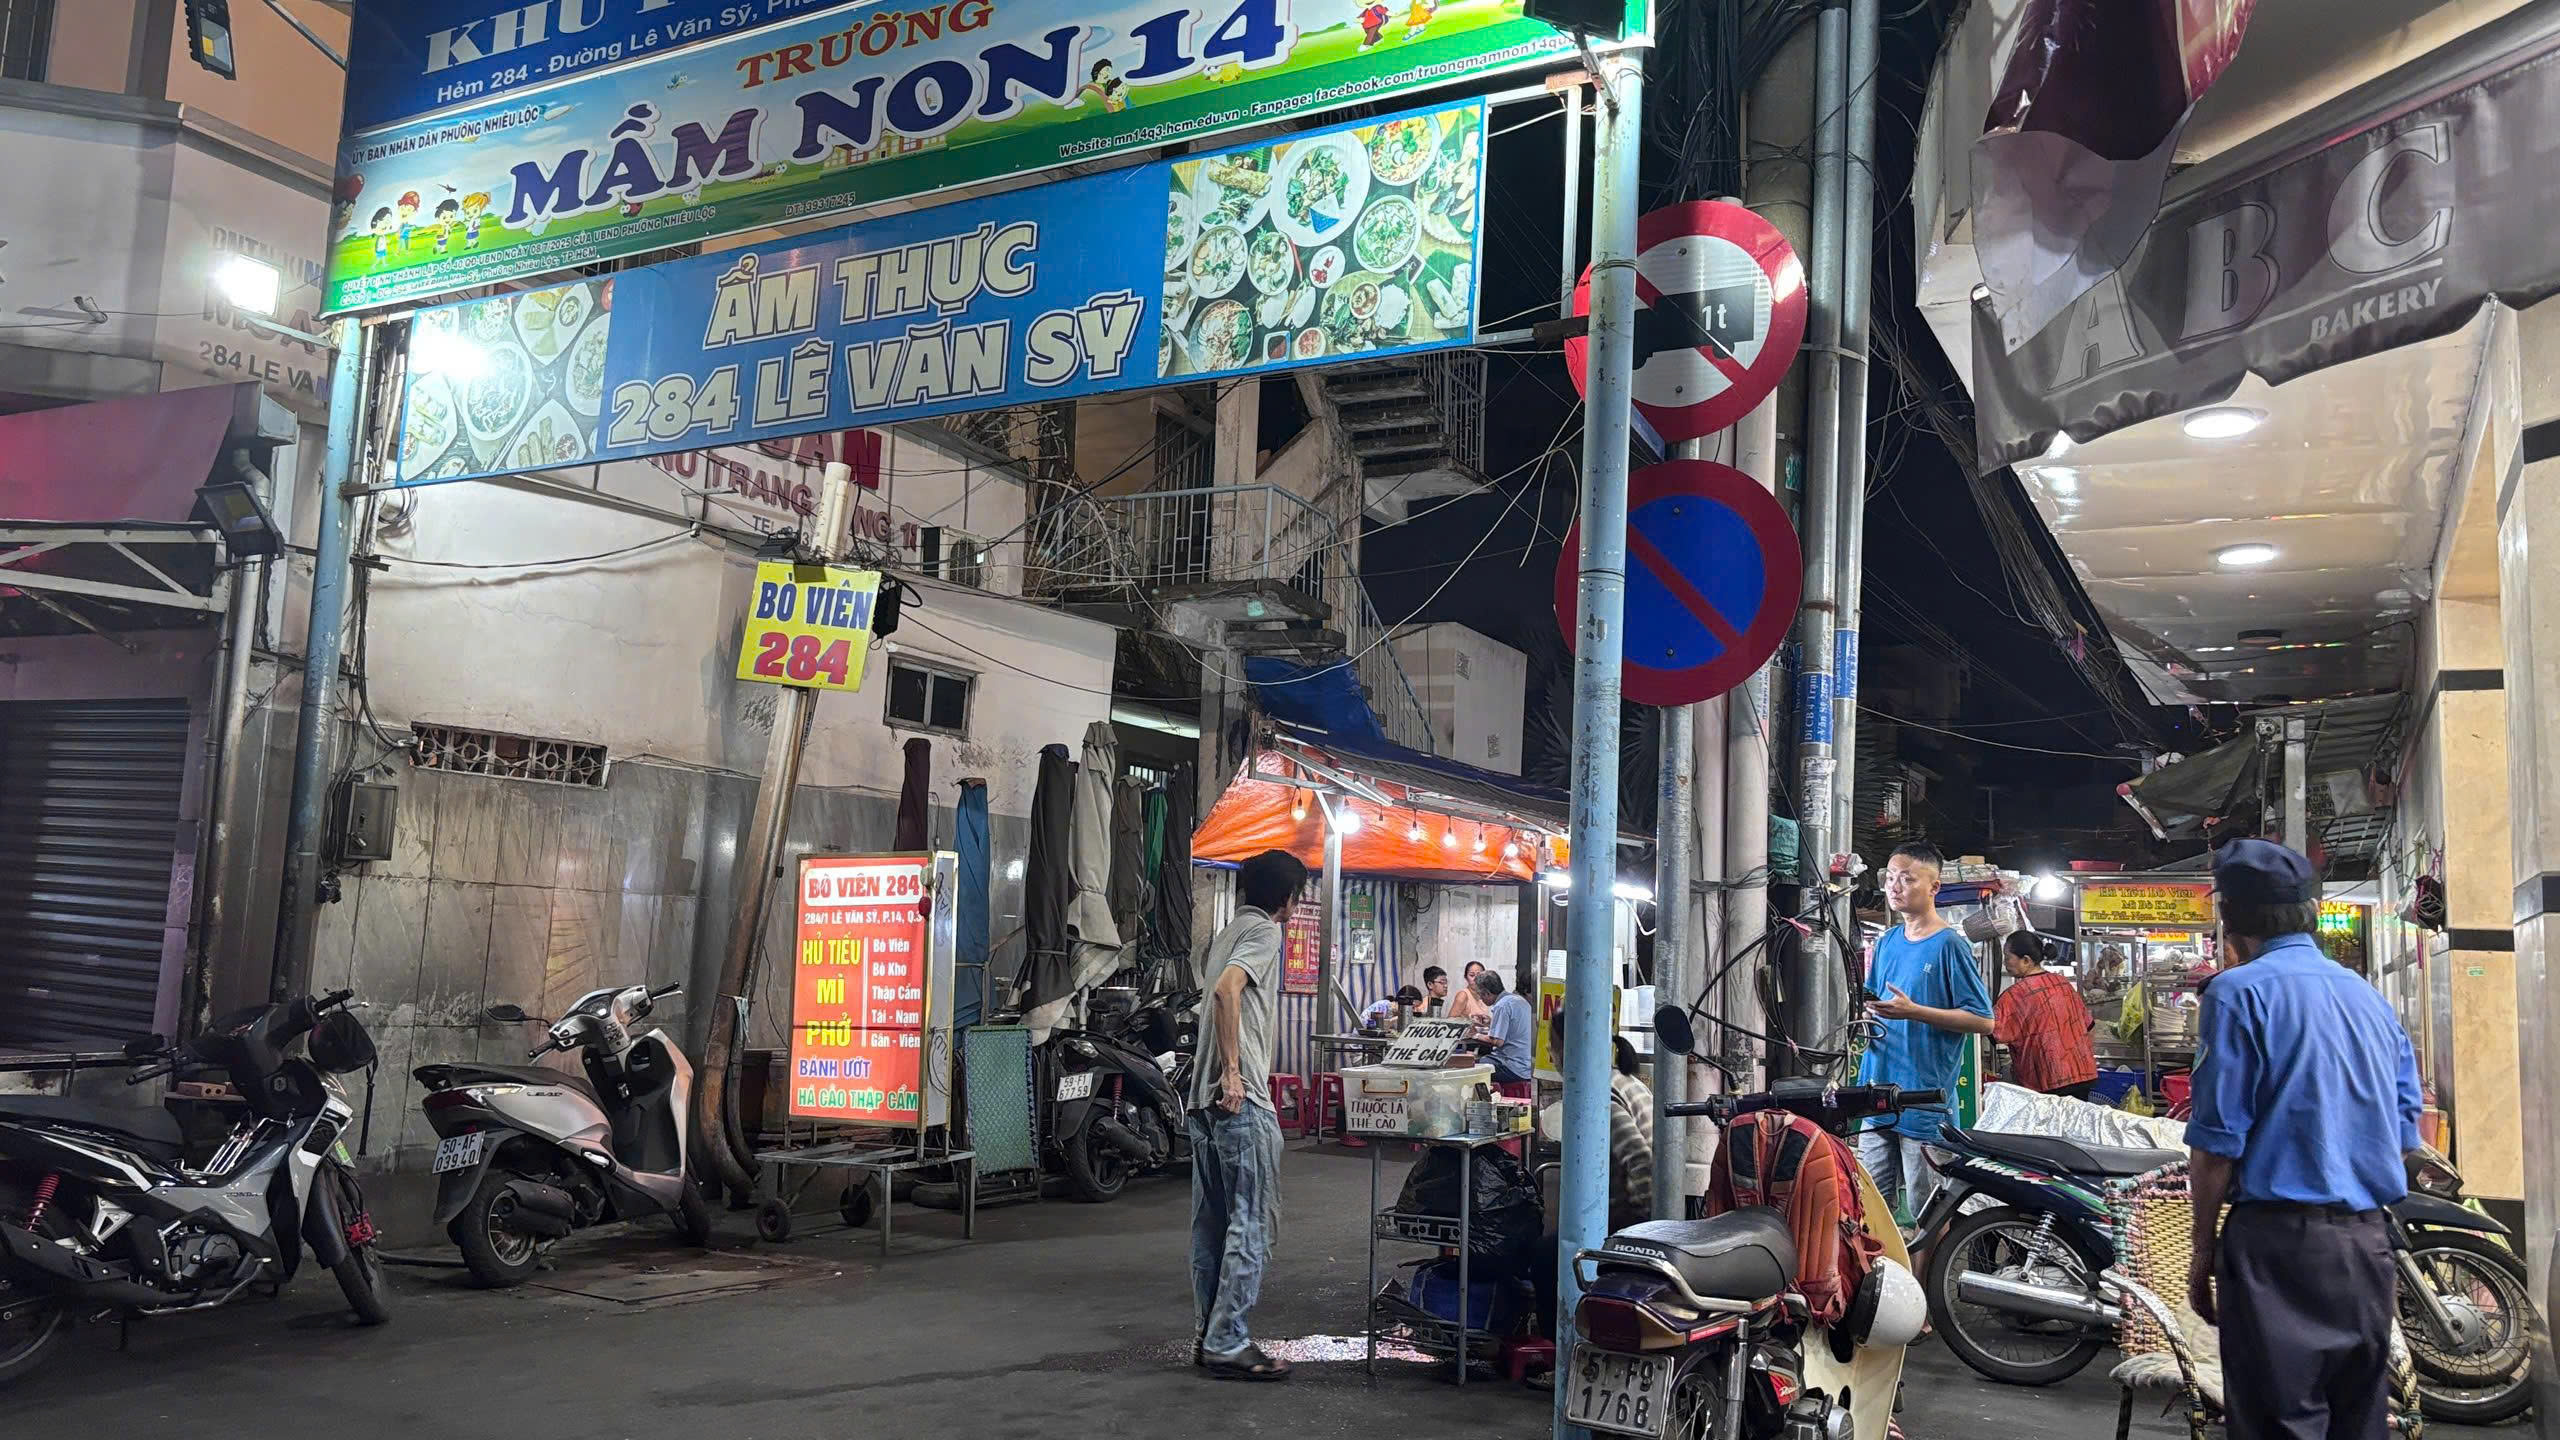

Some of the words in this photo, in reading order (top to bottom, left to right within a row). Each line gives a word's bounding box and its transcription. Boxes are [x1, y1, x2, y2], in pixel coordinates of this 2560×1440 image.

[422, 0, 605, 75] KHU
[437, 77, 483, 103] Hẻm
[491, 64, 528, 88] 284
[548, 43, 622, 73] Đường
[629, 28, 658, 51] Lê
[666, 15, 711, 40] Văn
[719, 3, 758, 27] Sỹ,
[737, 0, 992, 89] TRƯỜNG
[506, 104, 761, 223] MẦM
[793, 25, 1080, 161] NON
[1126, 0, 1287, 79] 14
[1060, 137, 1111, 157] Website:
[1114, 110, 1239, 146] mn14q3.hcm.edu.vn
[1251, 93, 1312, 117] Fanpage:
[1314, 36, 1575, 101] facebook.com/truongmamnon14qu
[367, 144, 387, 162] BAN
[389, 136, 416, 157] NHÂN
[418, 129, 438, 148] DÂN
[440, 124, 482, 144] PHƯỜNG
[484, 112, 515, 133] NHIÊU
[519, 104, 539, 127] LỘC
[805, 192, 856, 212] 39317245
[572, 229, 592, 245] CỦA
[593, 223, 619, 241] UBND
[621, 217, 661, 238] PHƯỜNG
[662, 211, 694, 229] NHIÊU
[697, 205, 716, 223] LỘC
[2049, 121, 2453, 391] ABC
[705, 254, 821, 350] ẨM
[835, 221, 1038, 324] THỰC
[1702, 303, 1727, 330] 1t
[2311, 278, 2442, 340] BAKERY
[199, 341, 242, 371] 284
[248, 354, 280, 384] LE
[608, 366, 738, 448] 284
[752, 340, 835, 428] LÊ
[848, 321, 1009, 414] VĂN
[1024, 289, 1144, 387] SỸ
[709, 453, 813, 516] TRANG
[756, 573, 797, 621] BÒ
[805, 580, 874, 630] VIÊN
[754, 632, 851, 685] 284
[837, 872, 880, 897] VIÊN
[886, 875, 920, 896] 284
[805, 913, 828, 925] 284/1
[831, 910, 842, 924] LÊ
[845, 910, 864, 924] VĂN
[802, 931, 823, 965] HỦ
[828, 931, 861, 965] TIẾU
[889, 937, 910, 952] Viên
[817, 973, 844, 1004] MÌ
[888, 962, 907, 976] Kho
[806, 1011, 852, 1047] PHỞ
[871, 1009, 886, 1023] Tái
[800, 1055, 838, 1077] BÁNH
[844, 1055, 871, 1078] ƯỚT
[1063, 1074, 1087, 1088] 59-F1
[798, 1085, 815, 1106] HÁ
[850, 1087, 883, 1113] THẬP
[442, 1134, 477, 1154] 50-AF
[1614, 1243, 1667, 1260] HONDA
[1582, 1386, 1649, 1428] 1768
